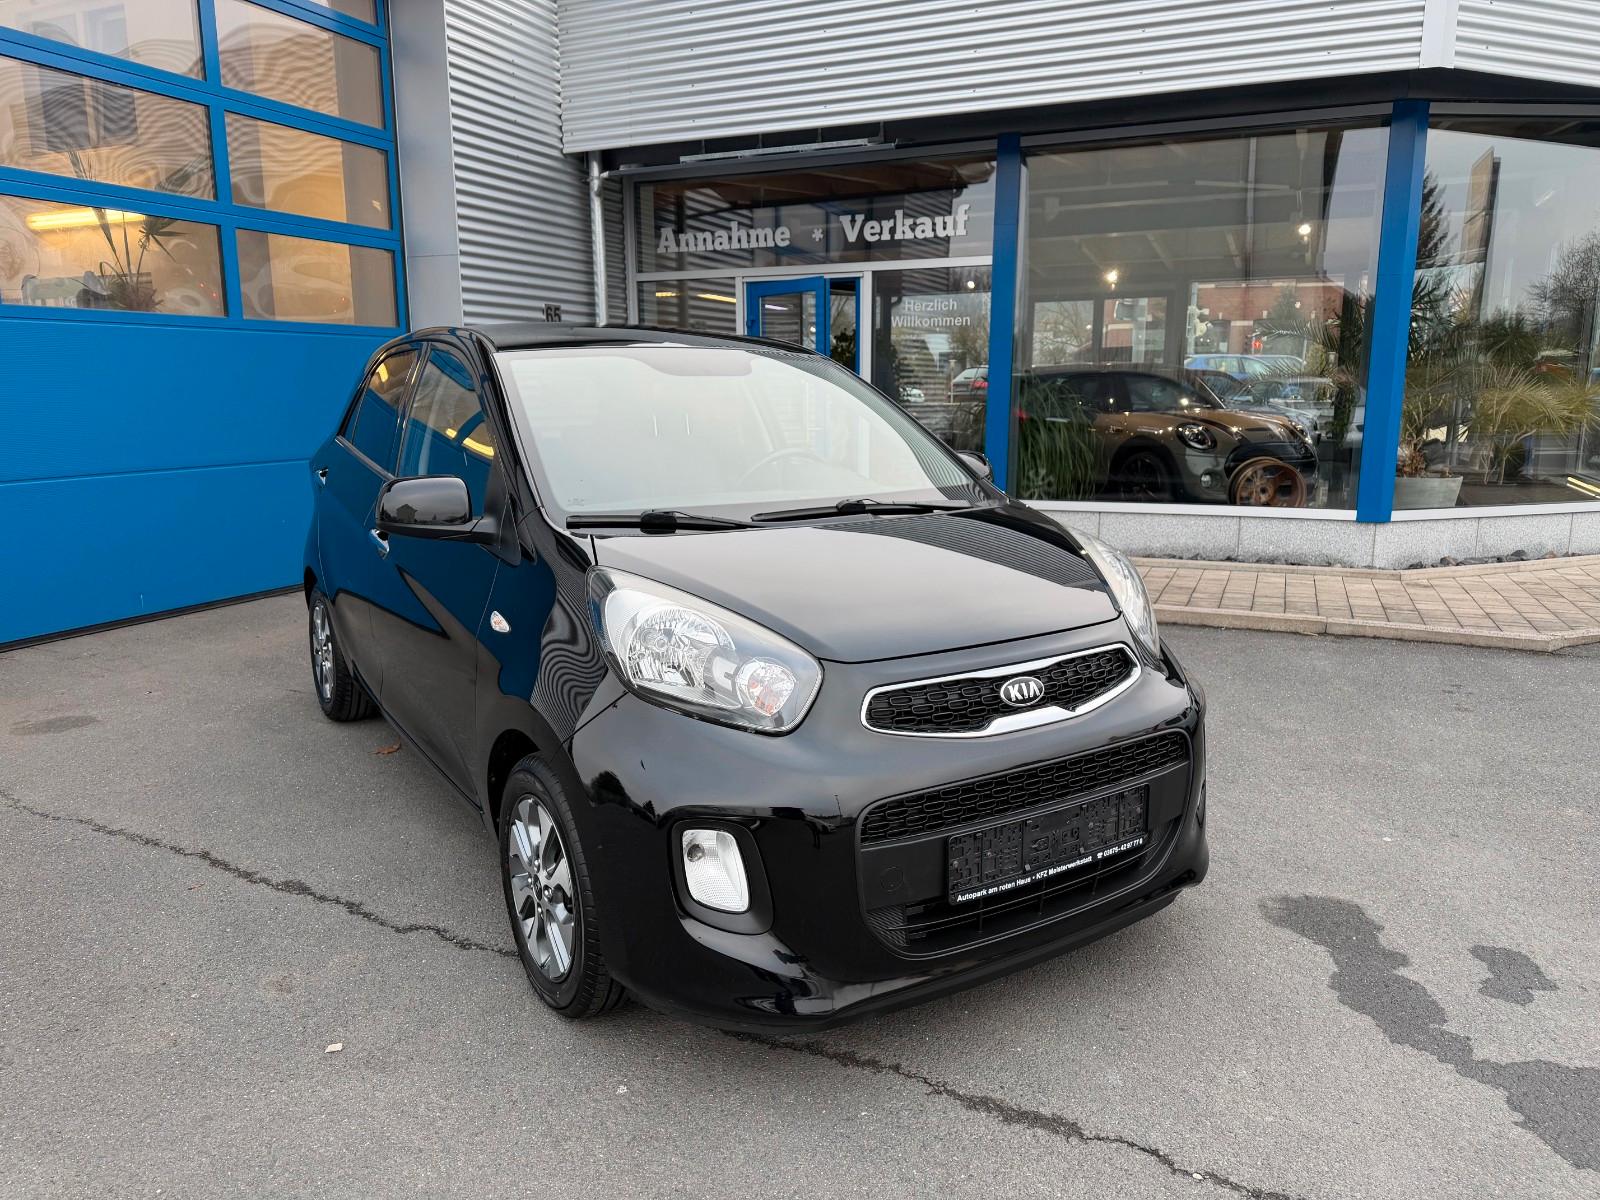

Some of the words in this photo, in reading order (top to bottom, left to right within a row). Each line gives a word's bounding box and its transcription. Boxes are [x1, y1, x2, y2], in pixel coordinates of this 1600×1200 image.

[657, 221, 791, 253] Annahme
[839, 204, 969, 242] Verkauf
[904, 299, 957, 312] Herzlich
[891, 315, 971, 328] Willkommen
[1007, 681, 1041, 701] KIA
[957, 888, 987, 902] Autopark
[988, 886, 998, 894] am
[999, 881, 1016, 892] roten
[1016, 876, 1031, 886] Haus
[1036, 870, 1048, 879] KFZ
